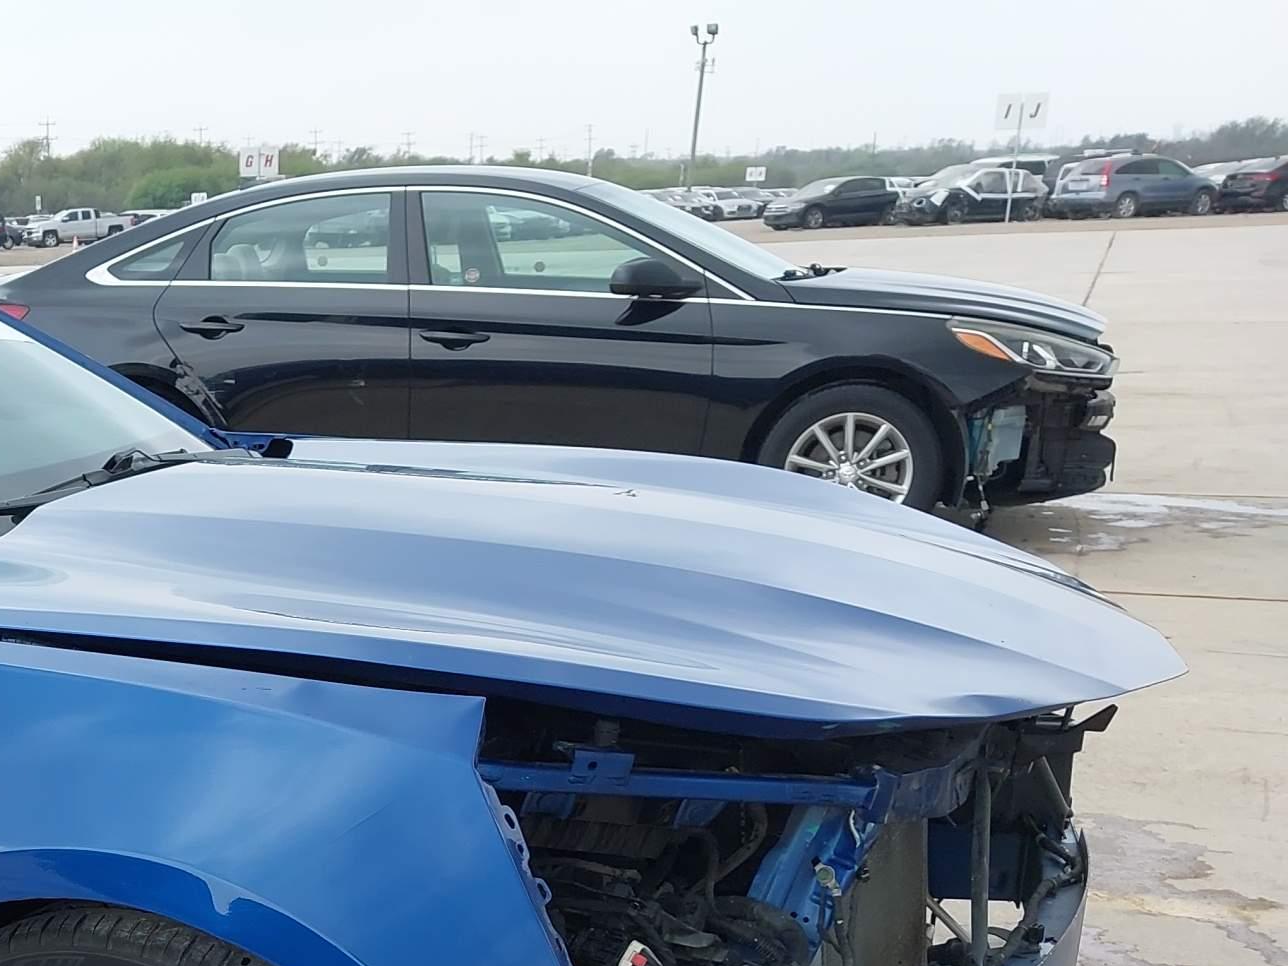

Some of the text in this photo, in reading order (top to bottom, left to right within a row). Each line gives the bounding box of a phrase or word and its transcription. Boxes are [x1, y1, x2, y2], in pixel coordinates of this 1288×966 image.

[1004, 102, 1041, 119] I J
[245, 154, 273, 168] G H
